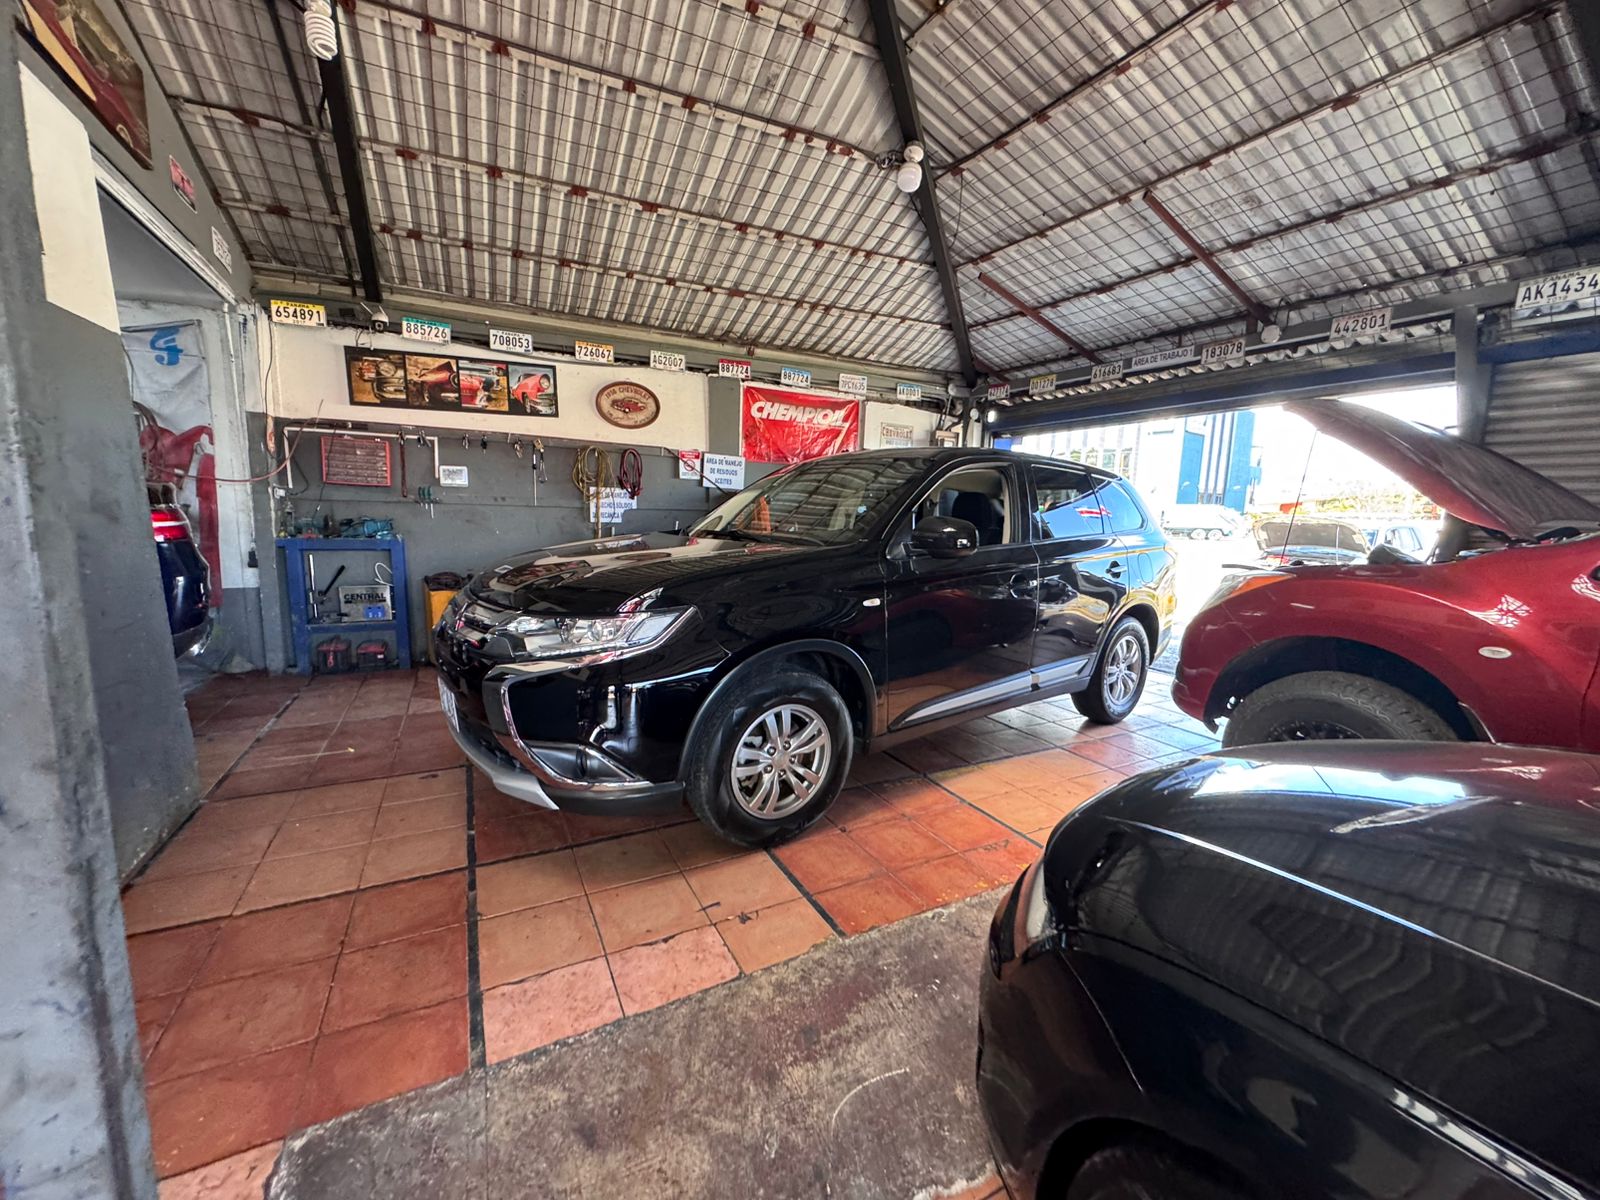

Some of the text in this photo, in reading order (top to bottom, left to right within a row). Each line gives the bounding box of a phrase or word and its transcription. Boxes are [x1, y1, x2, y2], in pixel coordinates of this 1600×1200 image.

[1521, 273, 1598, 303] AK1434
[275, 305, 321, 322] 654891
[405, 322, 447, 339] 885726
[1334, 313, 1386, 335] 442801
[492, 334, 530, 349] 708053
[577, 345, 612, 360] 726067
[1159, 349, 1189, 362] TRABAJO
[1204, 342, 1243, 359] 183078
[720, 363, 749, 375] 887724
[718, 458, 724, 466] DE
[724, 459, 743, 467] MANEJO
[716, 468, 738, 476] RESIDUOS
[715, 477, 732, 485] ACEITES
[344, 592, 386, 600] CENTRAL
